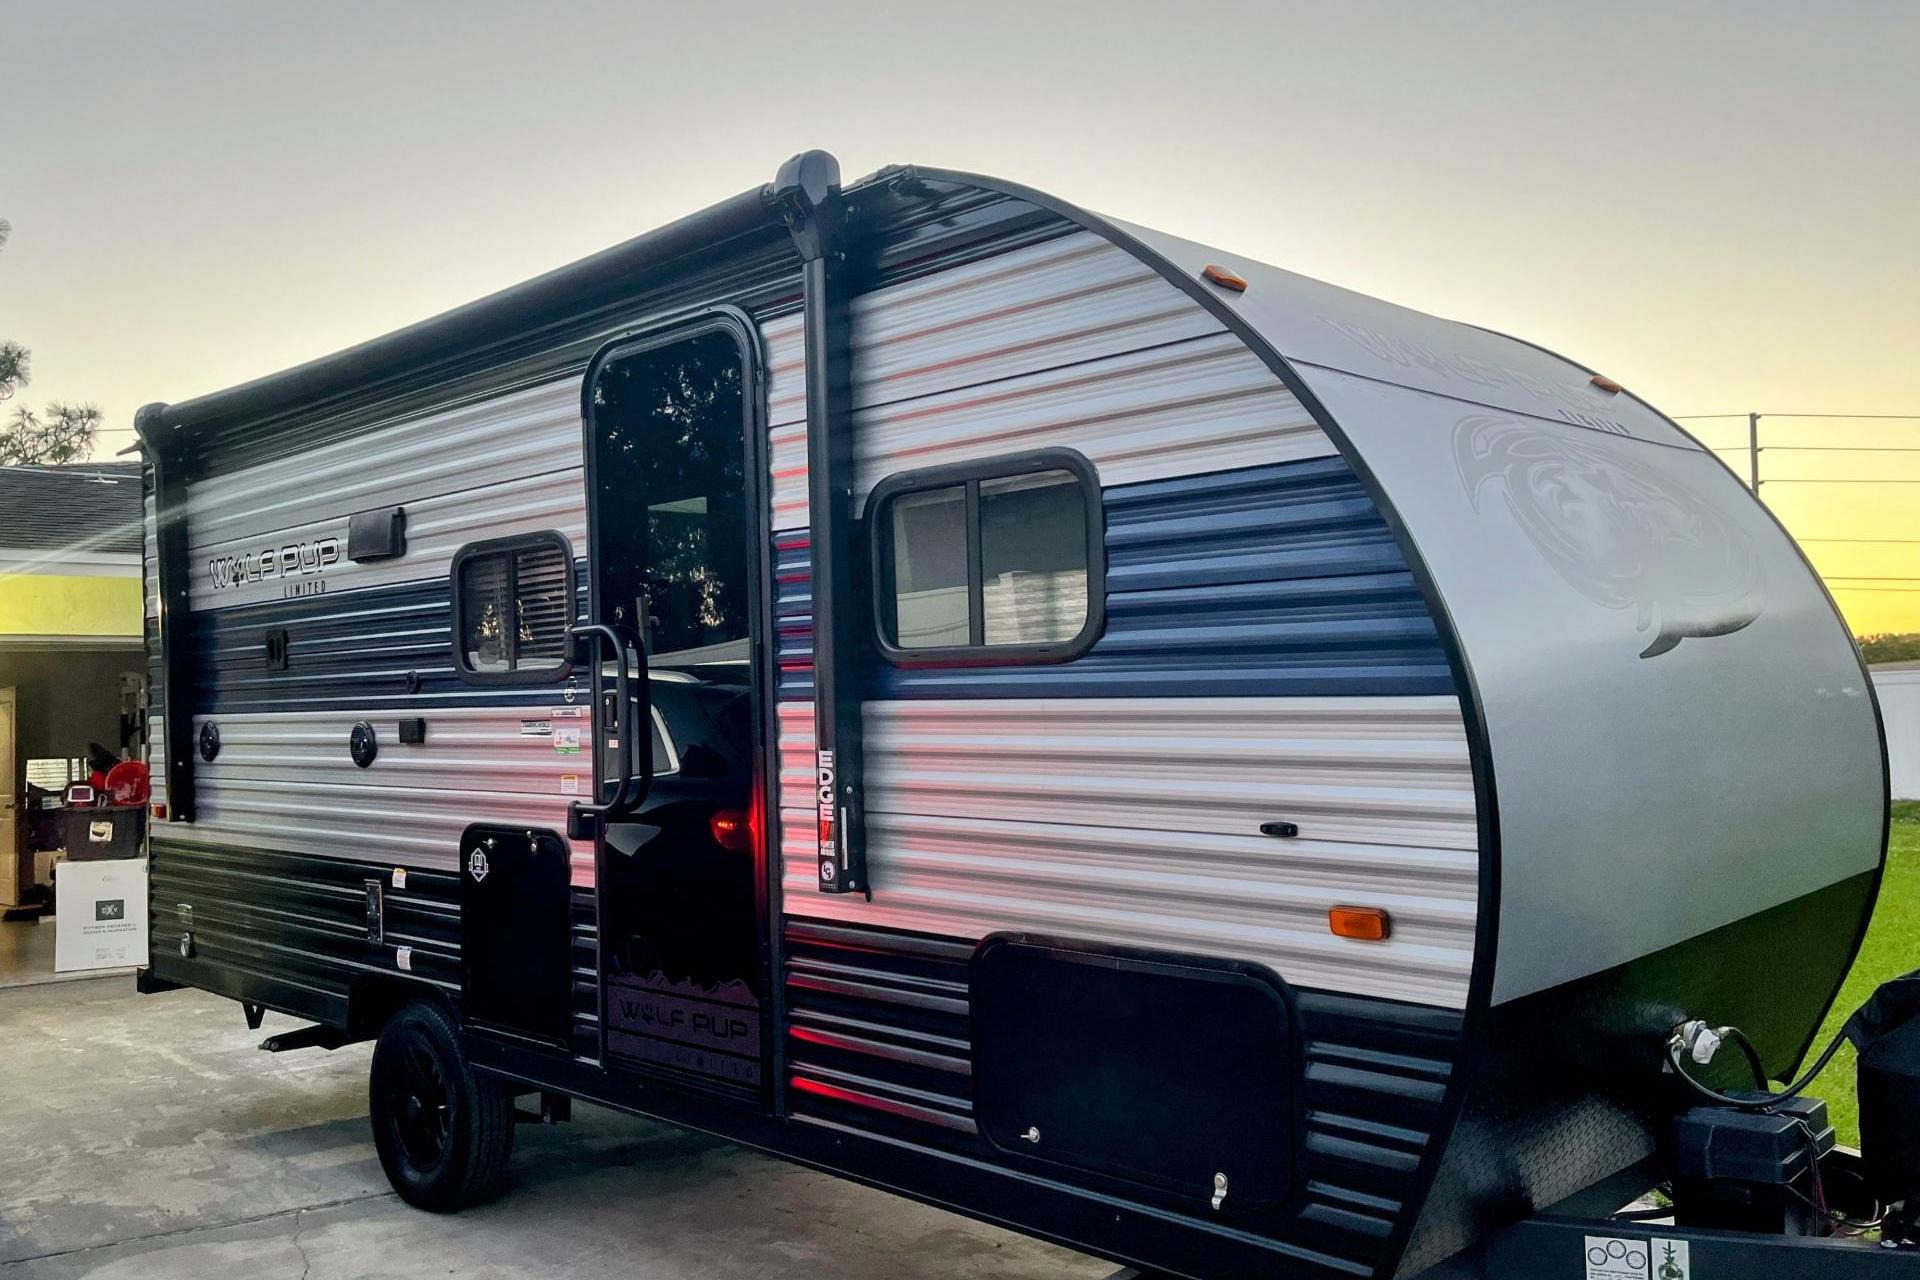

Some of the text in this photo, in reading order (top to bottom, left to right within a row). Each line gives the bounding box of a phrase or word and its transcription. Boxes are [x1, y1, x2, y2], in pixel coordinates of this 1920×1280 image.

[281, 537, 339, 578] PUP
[284, 580, 326, 598] LIMITED
[818, 750, 835, 822] EDGE
[692, 1012, 749, 1040] PUP
